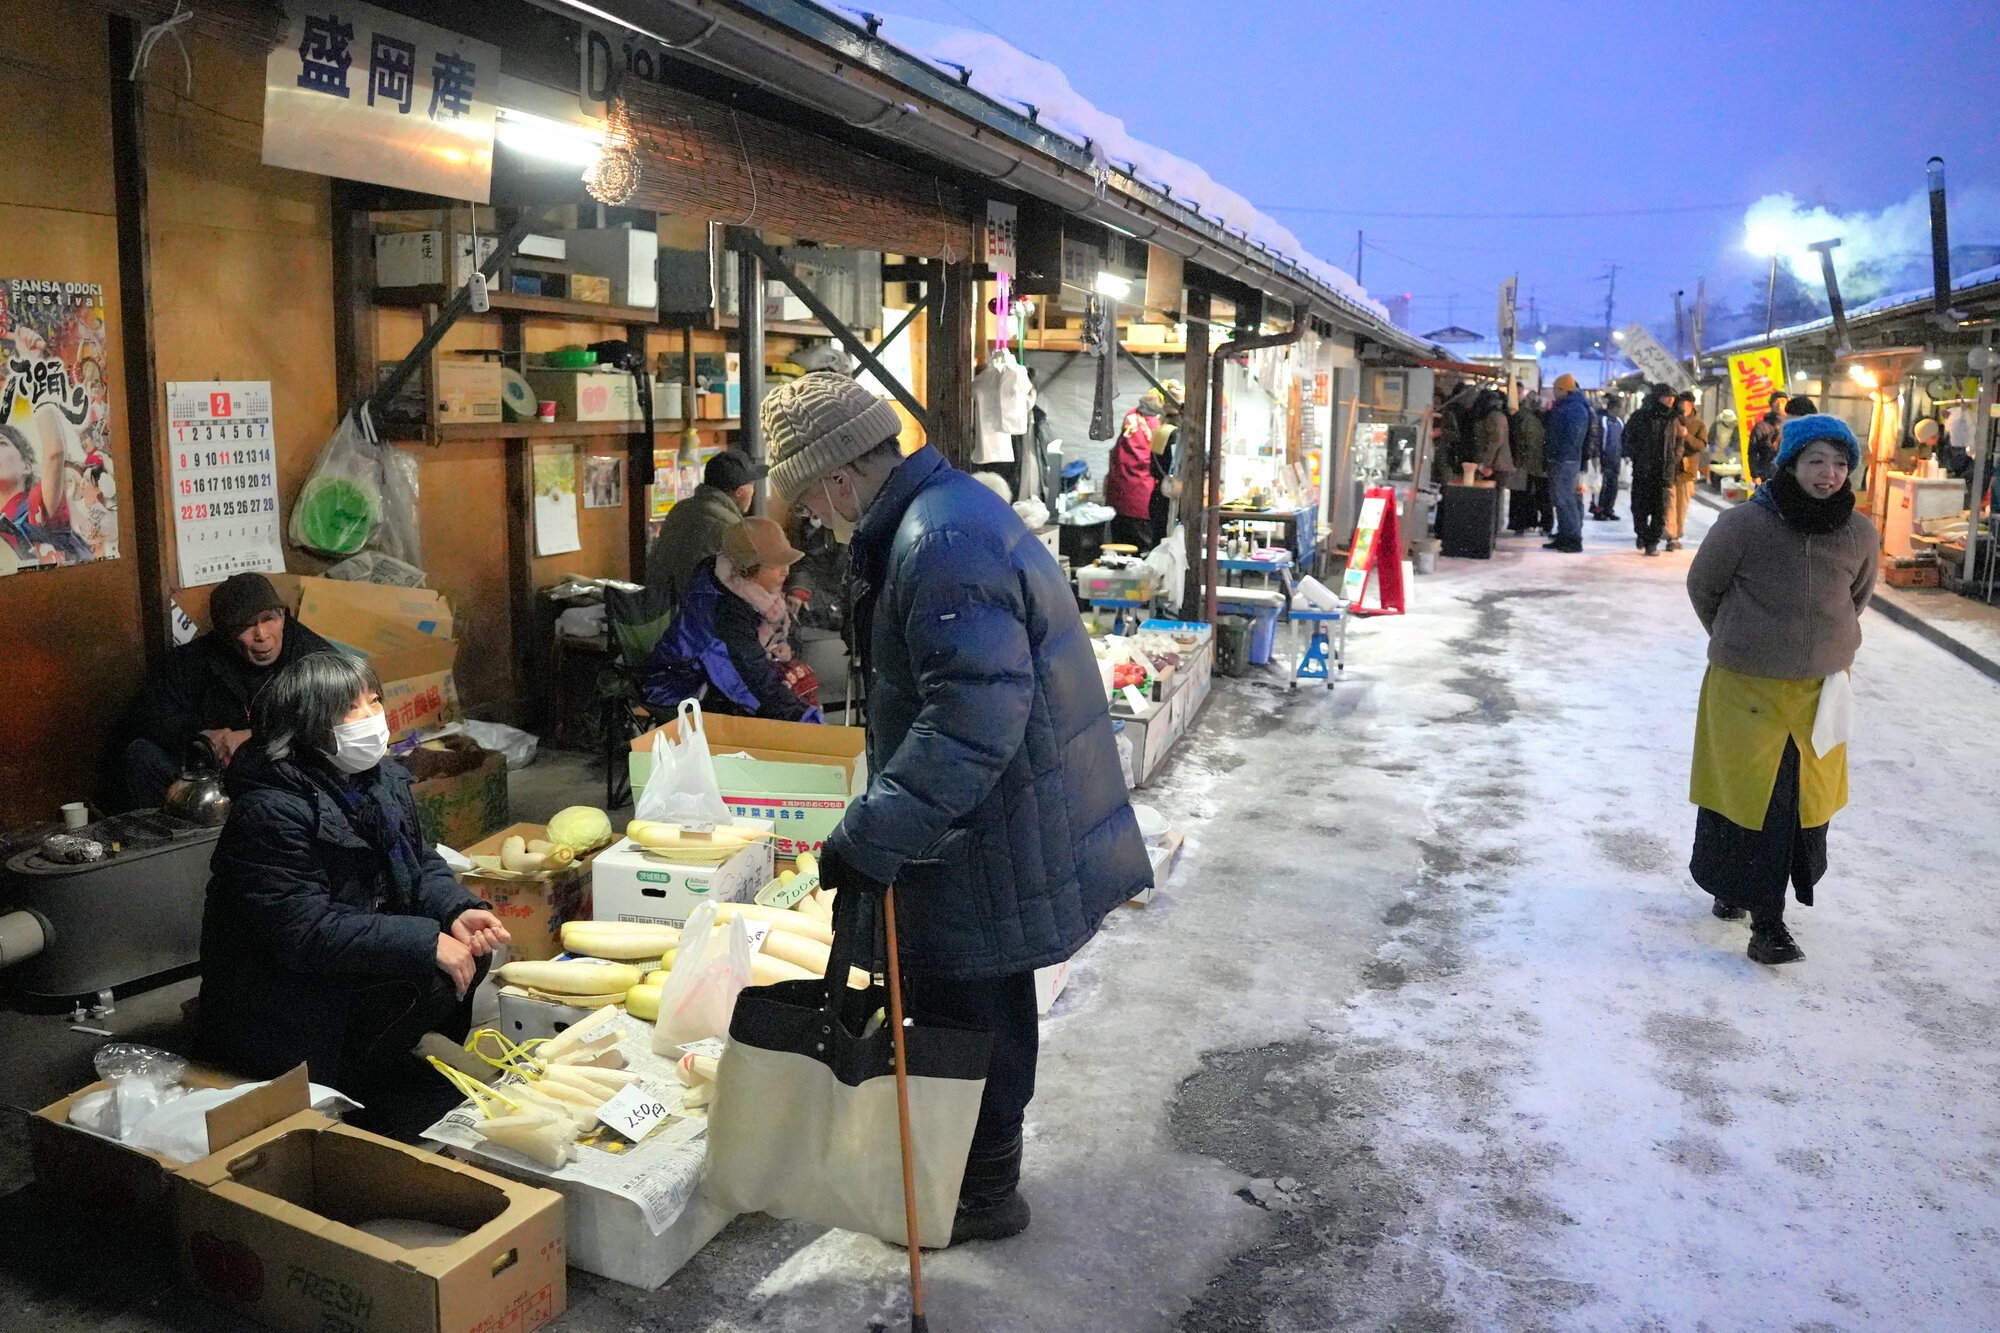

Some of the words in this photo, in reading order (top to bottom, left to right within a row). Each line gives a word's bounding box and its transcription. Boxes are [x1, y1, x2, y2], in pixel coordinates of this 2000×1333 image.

[297, 14, 476, 121] 盛岡産
[11, 280, 62, 293] SANSA
[65, 282, 102, 295] ODORI
[12, 292, 104, 307] Festival
[216, 395, 225, 415] 2
[178, 428, 183, 442] 1
[193, 427, 198, 441] 2
[206, 427, 212, 440] 3
[220, 426, 225, 439] 4
[234, 425, 239, 438] 5
[247, 425, 252, 438] 6
[260, 424, 265, 437] 7
[181, 454, 186, 468] 8
[194, 453, 200, 467] 9
[205, 452, 217, 466] 10
[219, 451, 230, 465] 11
[233, 451, 243, 464] 12
[247, 450, 257, 463] 13
[259, 449, 270, 462] 14
[180, 480, 191, 494] 15
[194, 479, 205, 492] 16
[208, 478, 218, 491] 17
[222, 477, 232, 490] 18
[235, 476, 245, 489] 19
[248, 475, 258, 488] 20
[261, 474, 271, 486] 21
[182, 506, 193, 520] 22
[196, 504, 207, 518] 23
[210, 504, 221, 516] 24
[224, 502, 234, 515] 25
[237, 501, 248, 514] 26
[250, 500, 260, 512] 27
[264, 498, 274, 511] 28
[624, 1103, 666, 1128] 250円
